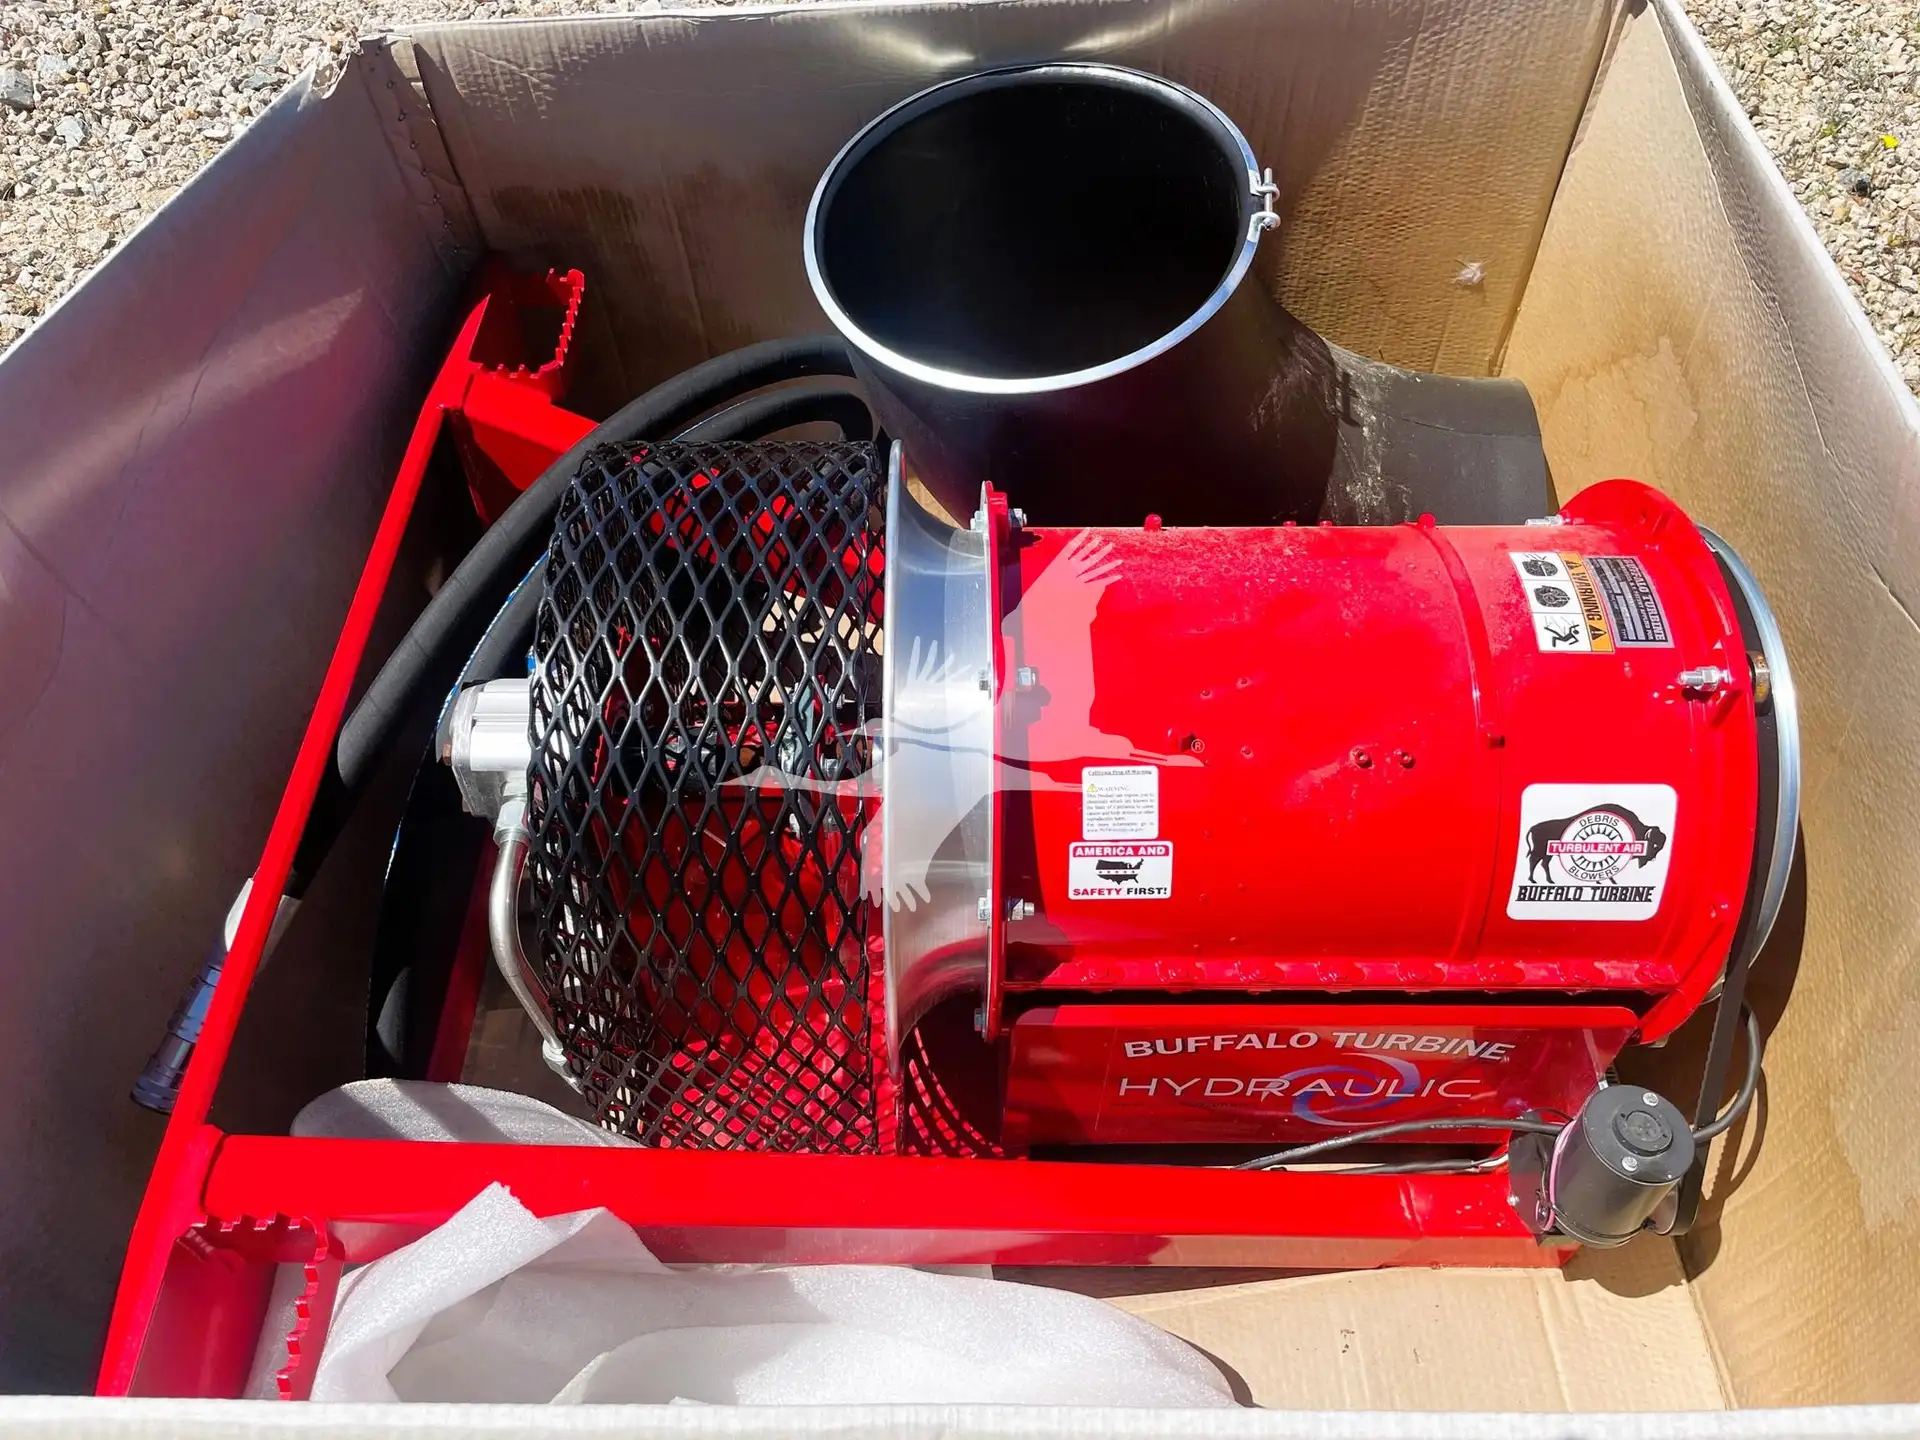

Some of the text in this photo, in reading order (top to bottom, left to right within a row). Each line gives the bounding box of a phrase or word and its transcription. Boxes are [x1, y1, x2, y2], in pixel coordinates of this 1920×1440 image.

[1572, 572, 1602, 622] WARNING
[1623, 558, 1650, 593] BUFFALO
[1642, 594, 1666, 641] TURBINE
[1579, 814, 1620, 828] DEBRIS
[1076, 846, 1166, 856] AMERICA AND
[1550, 843, 1643, 853] TURBULENT AIR
[1568, 865, 1620, 881] BLOWERS
[1073, 887, 1168, 896] SAFETY FIRST!
[1516, 886, 1656, 902] BUFFALO TURBINE
[1124, 1032, 1516, 1061] BUFFALO TURBINE
[1118, 1078, 1481, 1098] HYDRAULIC
